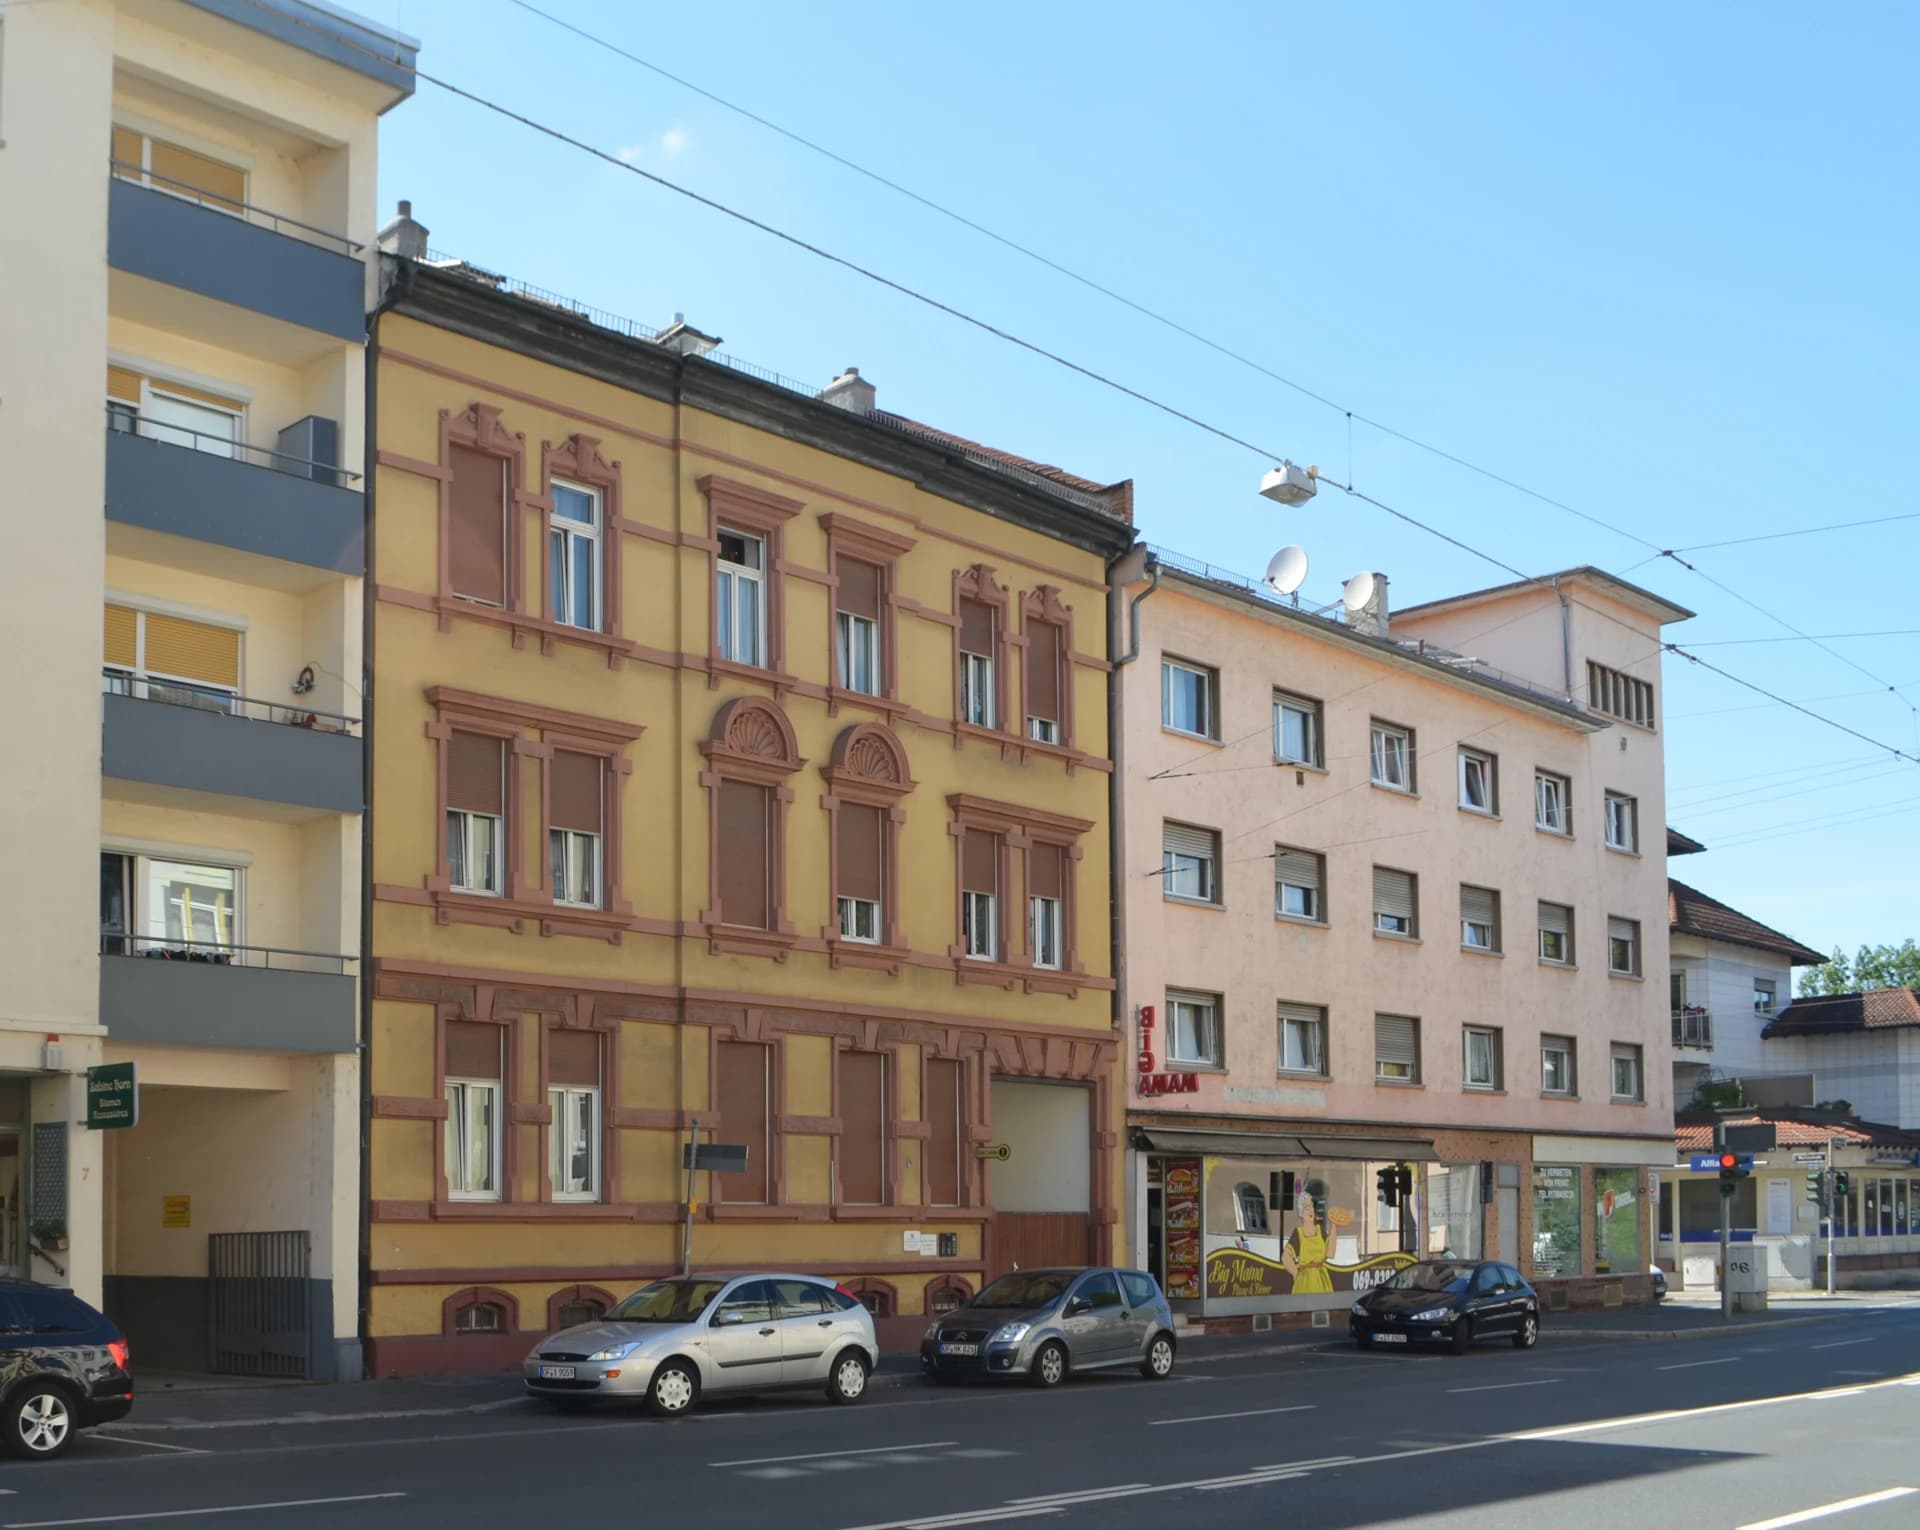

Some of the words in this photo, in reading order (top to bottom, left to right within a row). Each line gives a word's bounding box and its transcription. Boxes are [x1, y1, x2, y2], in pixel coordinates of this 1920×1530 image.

[82, 1167, 90, 1181] 7
[1208, 1260, 1230, 1295] Big
[1231, 1259, 1264, 1284] Mama
